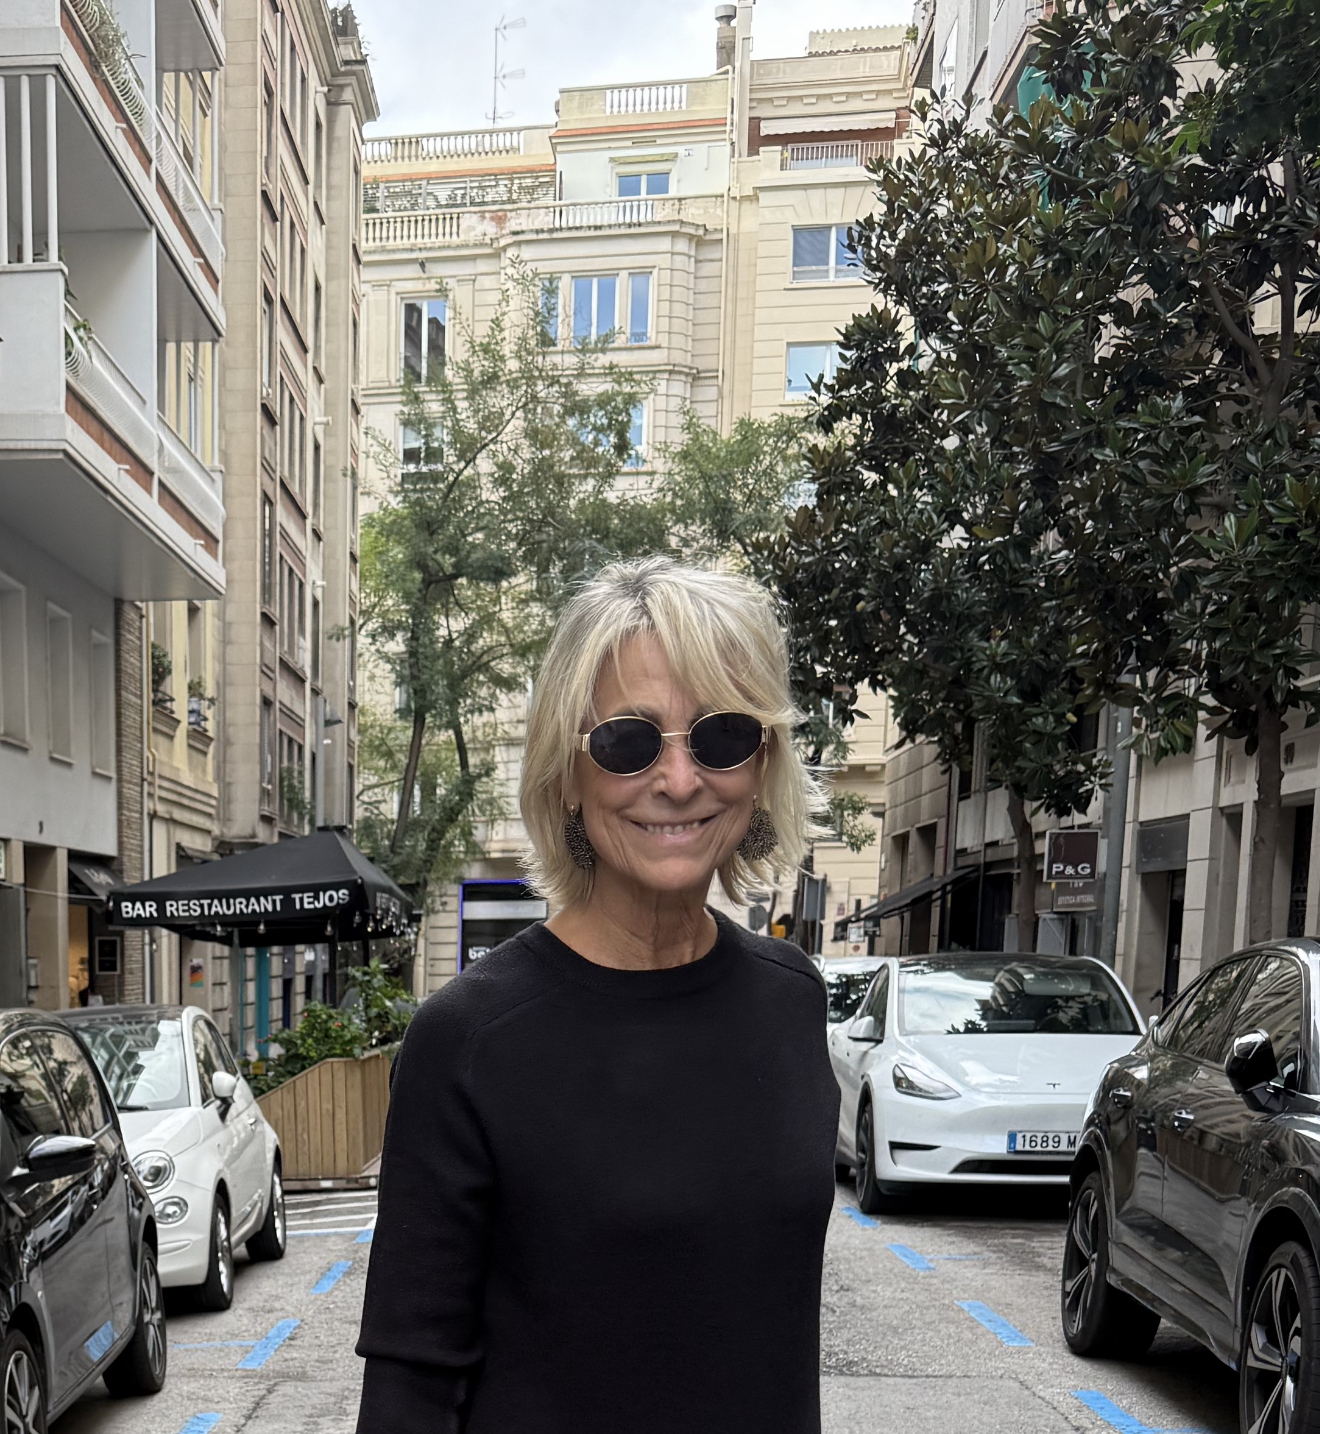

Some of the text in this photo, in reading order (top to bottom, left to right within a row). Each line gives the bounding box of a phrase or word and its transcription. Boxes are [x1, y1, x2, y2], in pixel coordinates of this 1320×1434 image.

[1052, 863, 1091, 875] P&G
[120, 901, 158, 918] BAR
[165, 895, 284, 918] RESTAURANT
[291, 889, 350, 910] TEJOS
[1021, 1134, 1077, 1149] 1689 M
